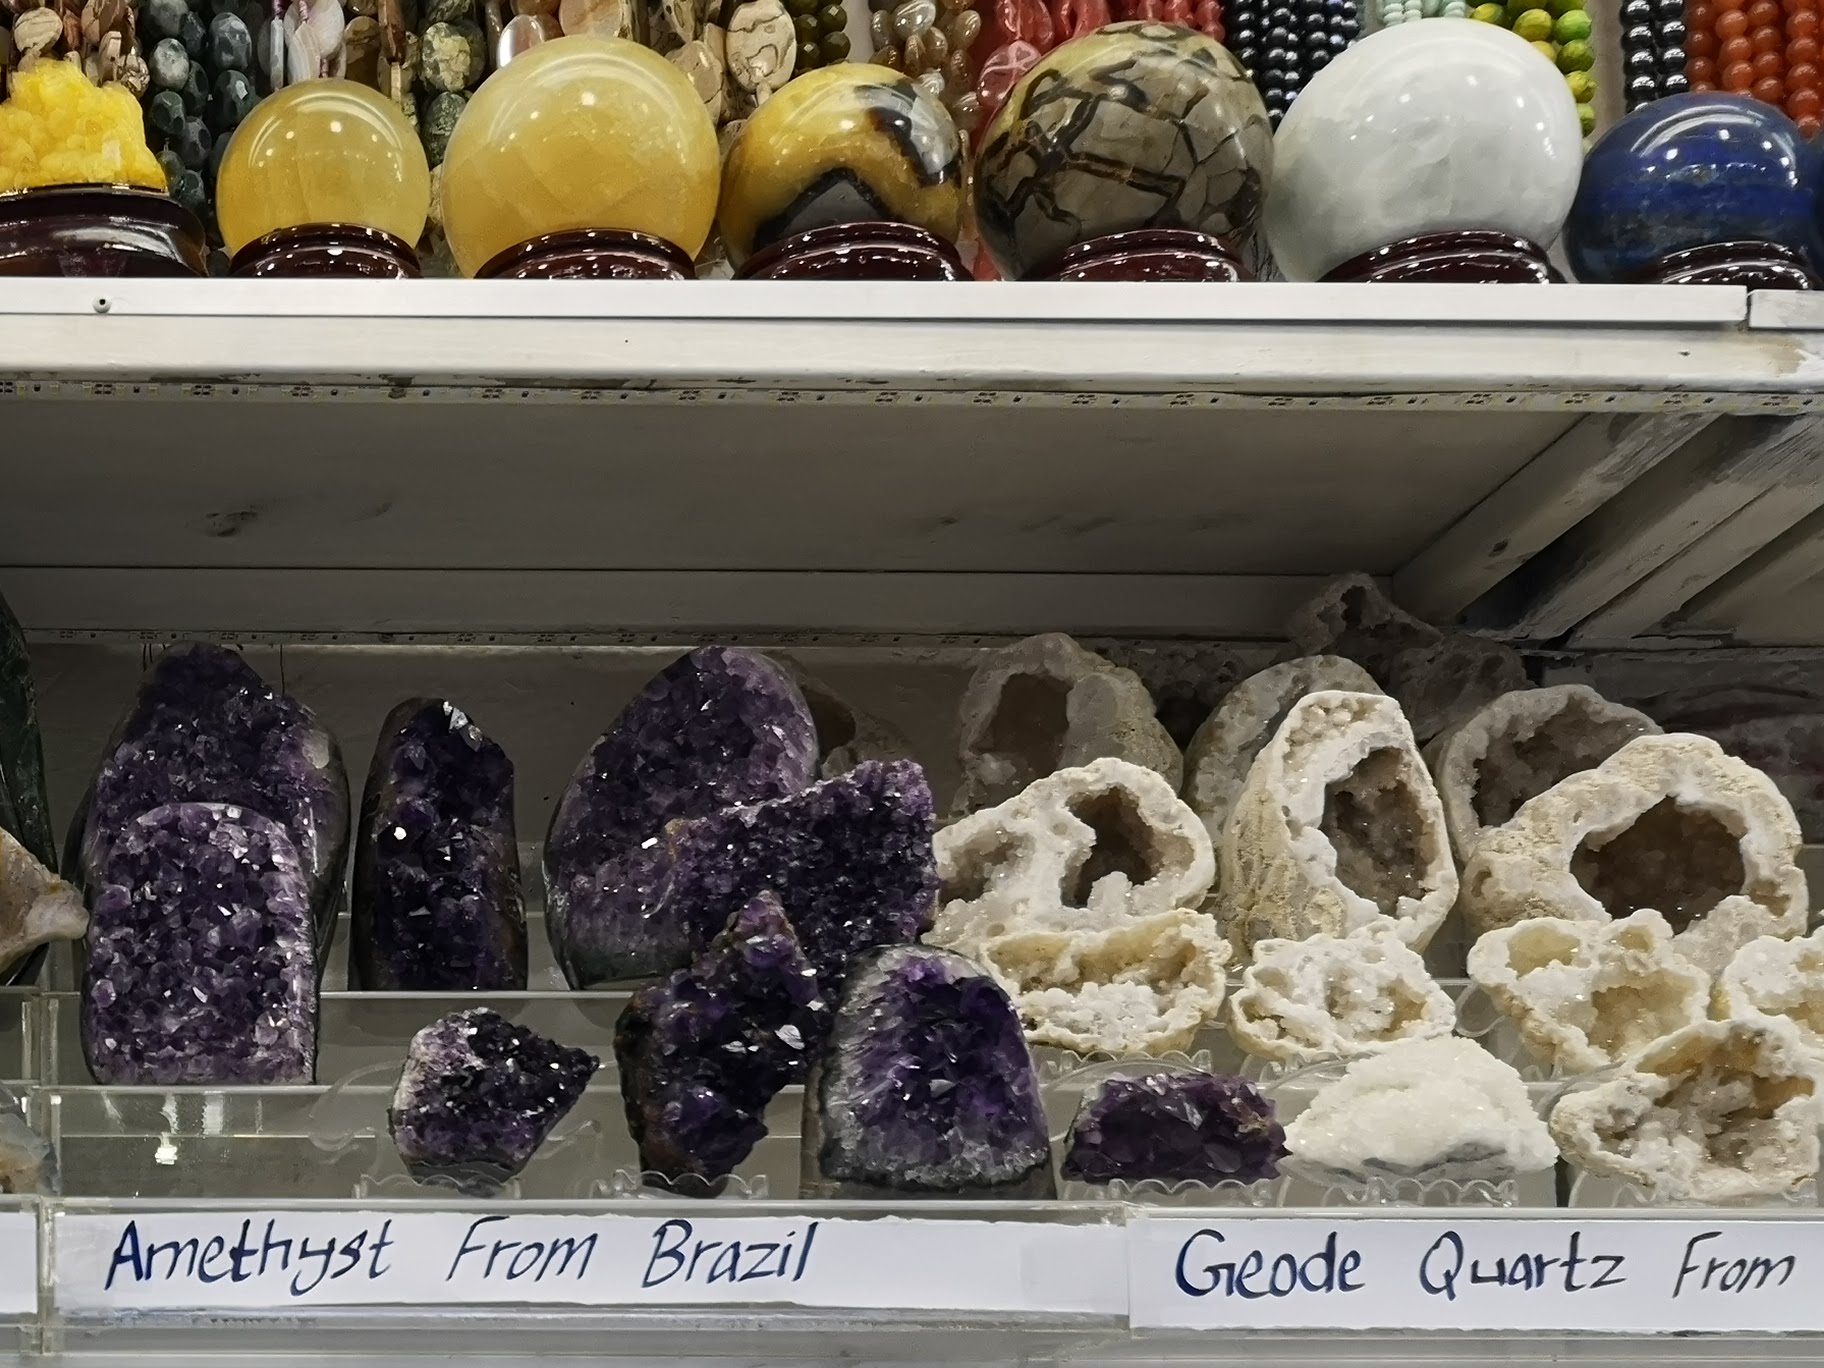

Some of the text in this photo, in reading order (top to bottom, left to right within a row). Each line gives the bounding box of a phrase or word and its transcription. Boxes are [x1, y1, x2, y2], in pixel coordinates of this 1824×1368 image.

[103, 1215, 820, 1297] Amethyst From Brazil
[1174, 1228, 1796, 1302] Geode Quartz From
